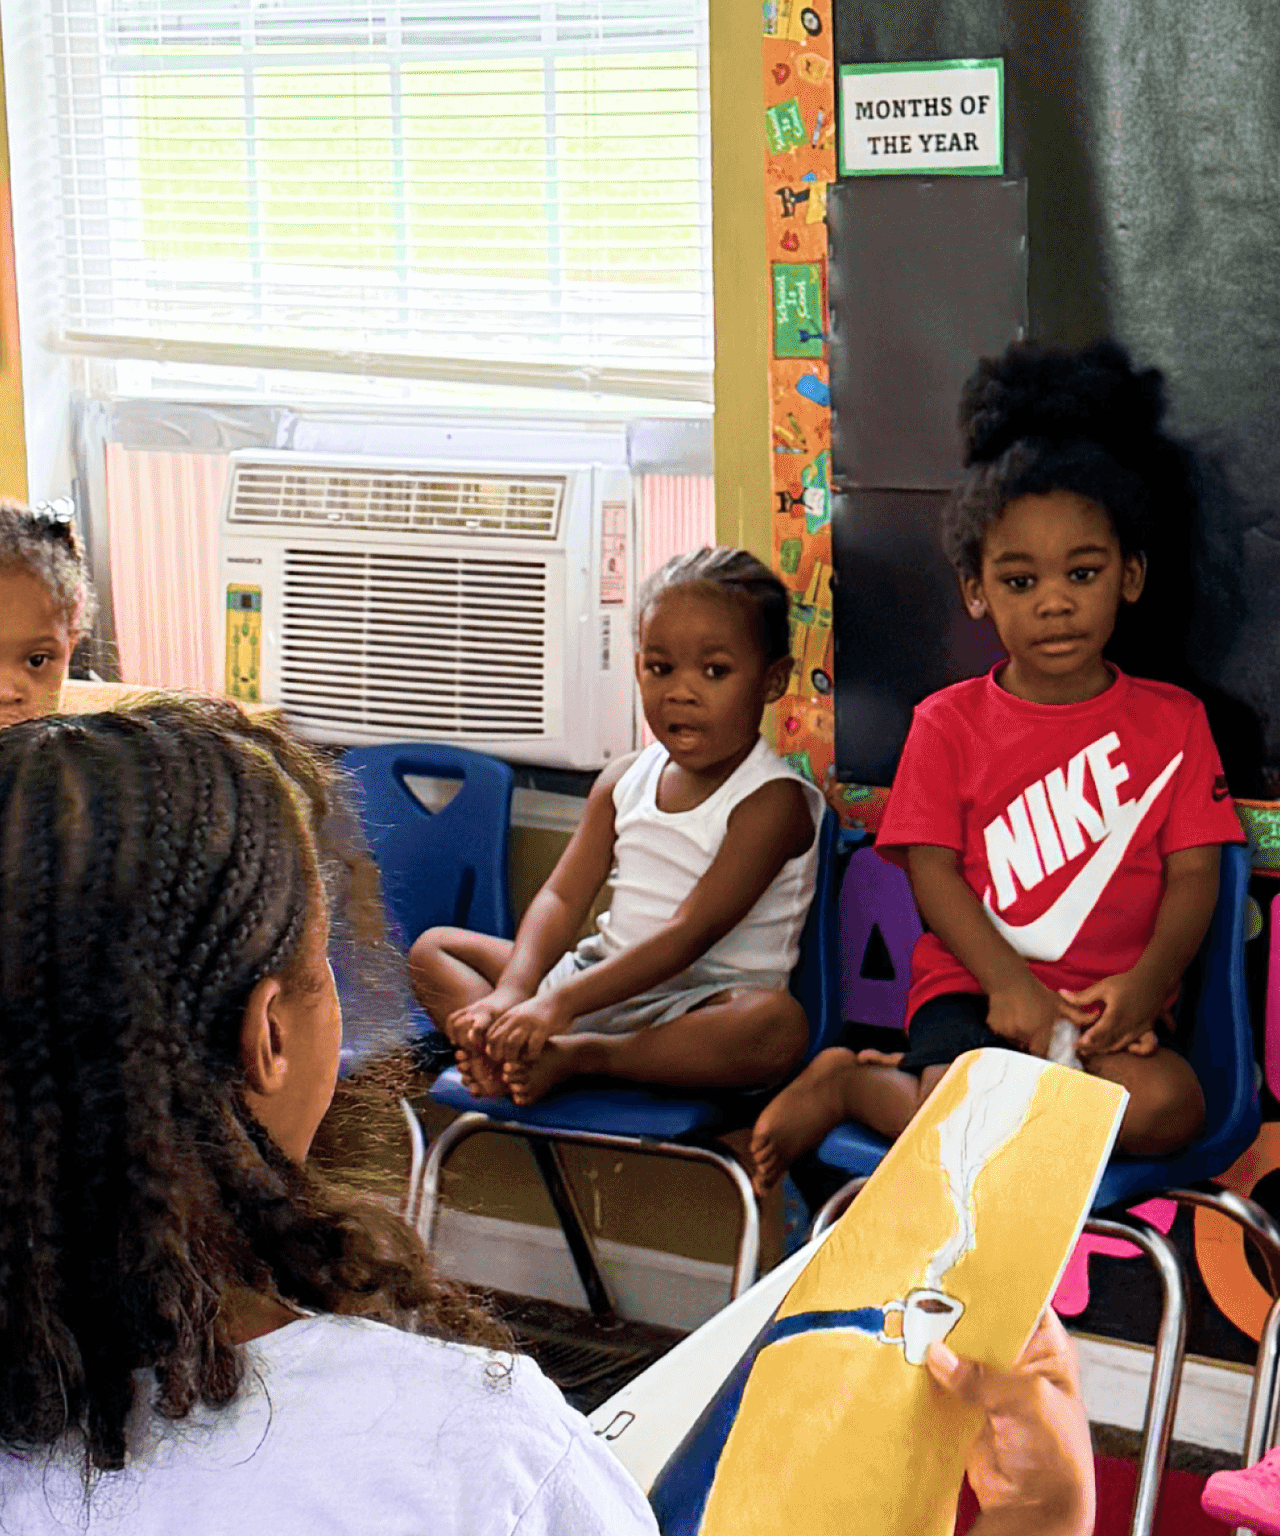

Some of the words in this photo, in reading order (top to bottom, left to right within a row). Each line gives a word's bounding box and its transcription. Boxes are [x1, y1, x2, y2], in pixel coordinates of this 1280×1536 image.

[855, 96, 952, 120] MONTHS
[960, 95, 990, 115] OF
[867, 135, 912, 155] THE
[918, 132, 979, 153] YEAR
[983, 731, 1136, 911] NIKE
